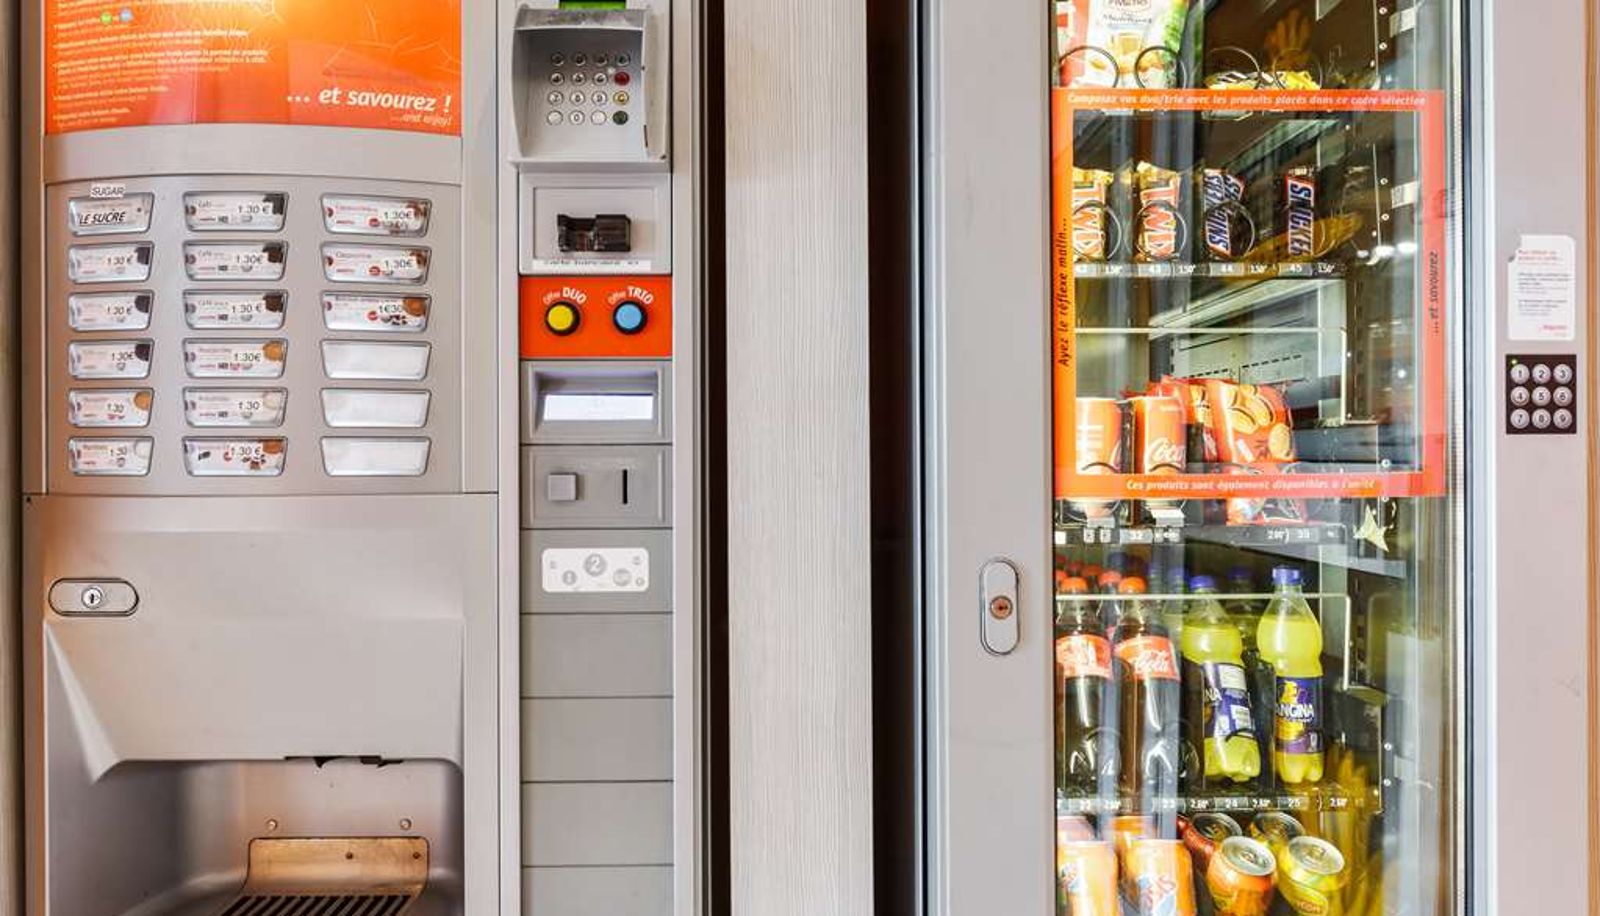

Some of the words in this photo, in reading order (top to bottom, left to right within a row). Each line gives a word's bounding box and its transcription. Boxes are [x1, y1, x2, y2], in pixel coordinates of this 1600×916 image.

[319, 87, 341, 104] et
[347, 89, 437, 112] savourez
[1231, 94, 1272, 106] produits
[1309, 94, 1334, 105] dans
[1351, 95, 1377, 106] cadre
[91, 186, 124, 197] SUGAR
[80, 213, 90, 225] LE
[91, 212, 126, 224] SUCRE
[1429, 249, 1440, 302] savourez
[562, 287, 587, 304] DUO
[627, 286, 654, 304] TRIO
[1058, 320, 1069, 332] le
[1058, 337, 1073, 367] Ayez
[1127, 480, 1144, 490] Ces
